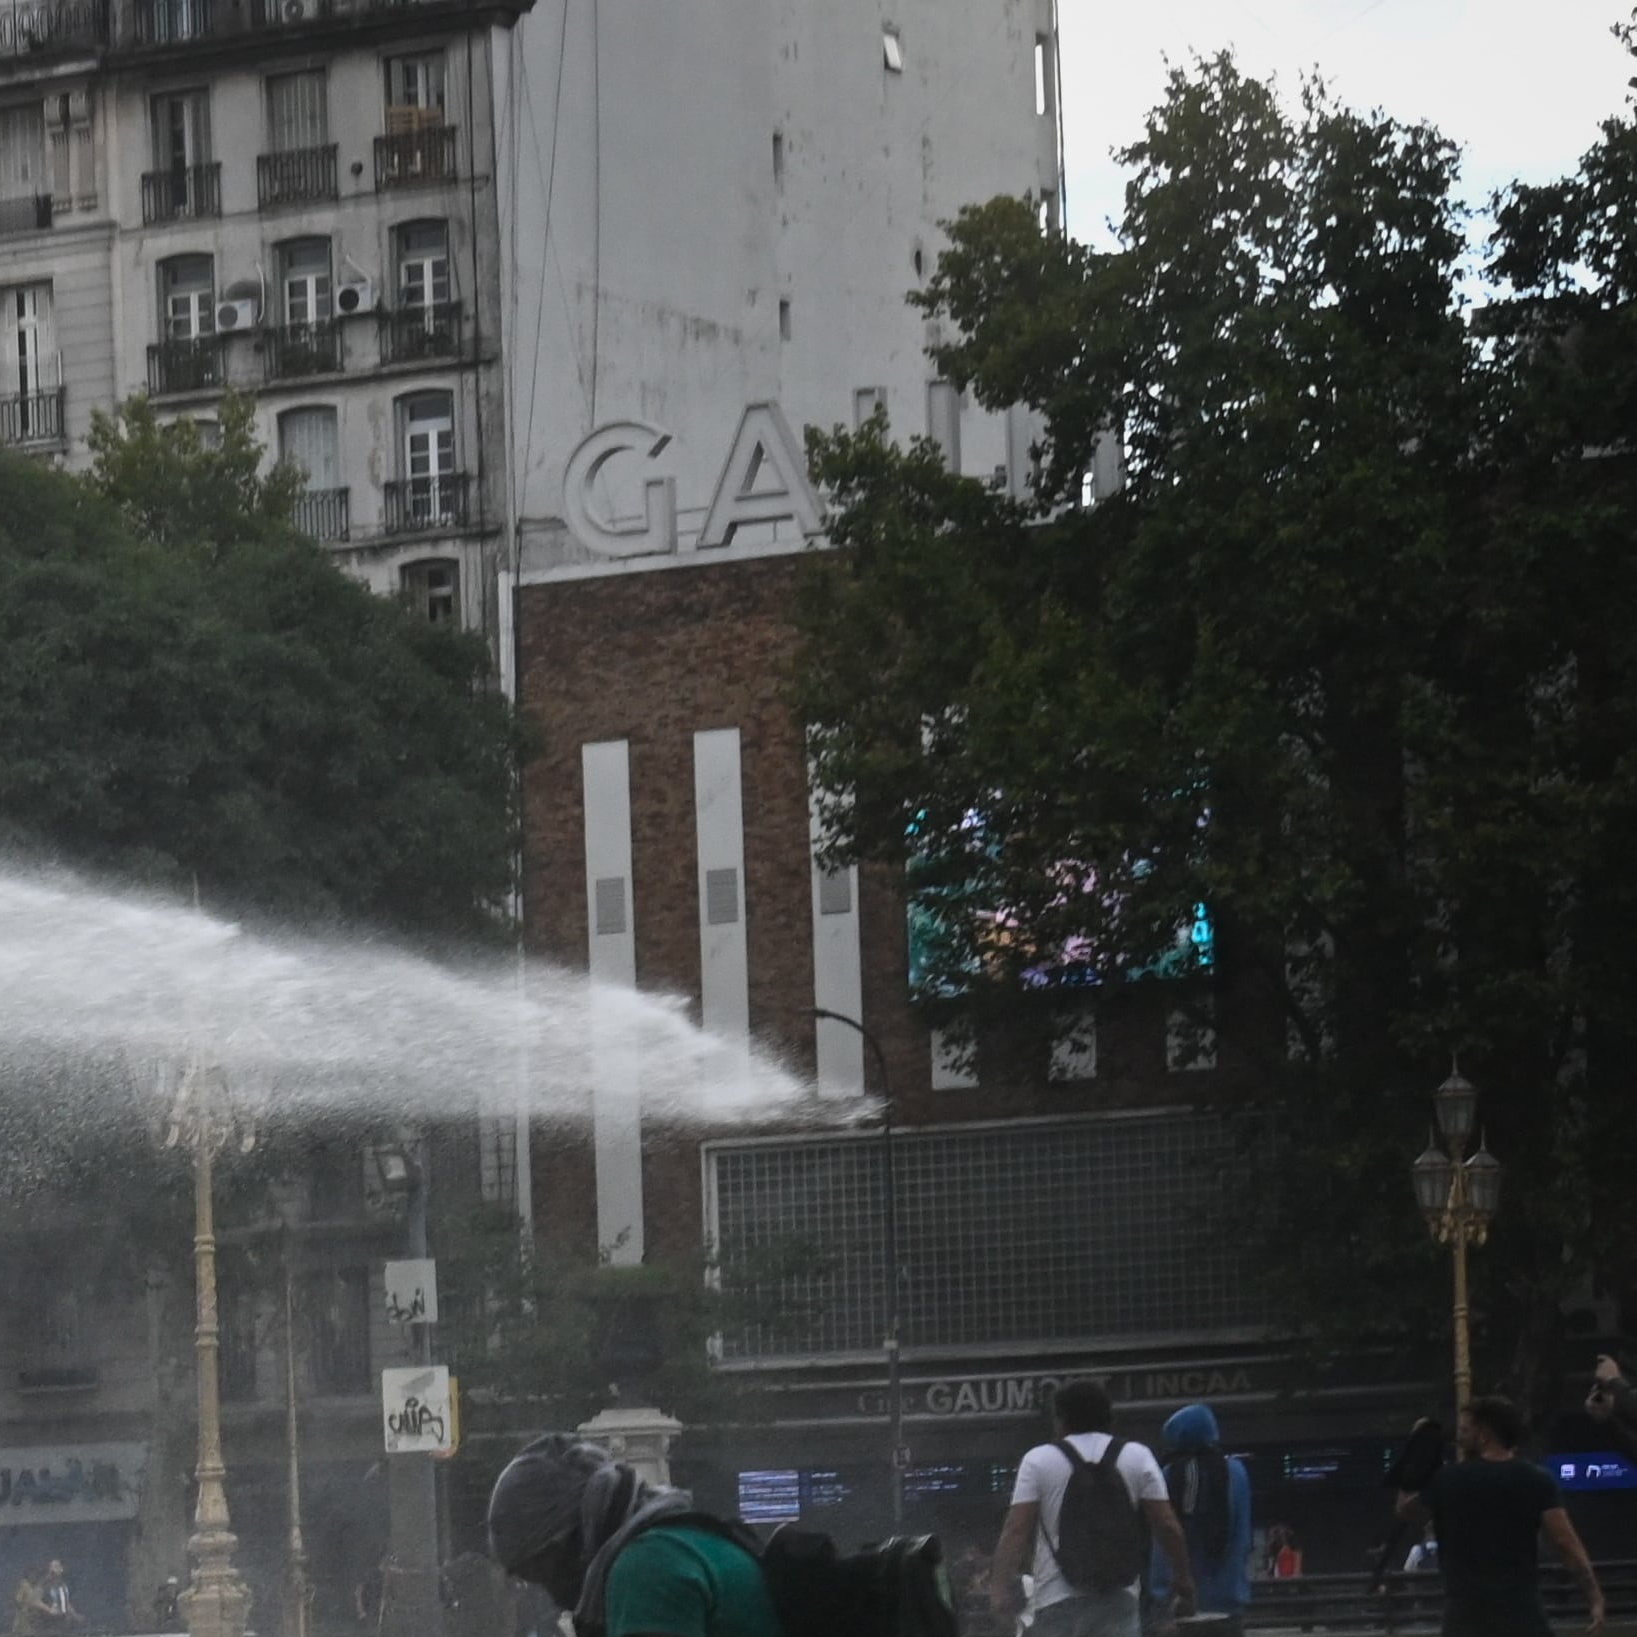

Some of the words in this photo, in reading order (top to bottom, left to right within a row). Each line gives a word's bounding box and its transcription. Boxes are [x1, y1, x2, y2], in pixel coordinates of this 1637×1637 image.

[857, 1390, 915, 1414] Cie
[926, 1374, 1112, 1415] GAUM
[1145, 1369, 1253, 1396] INCAA
